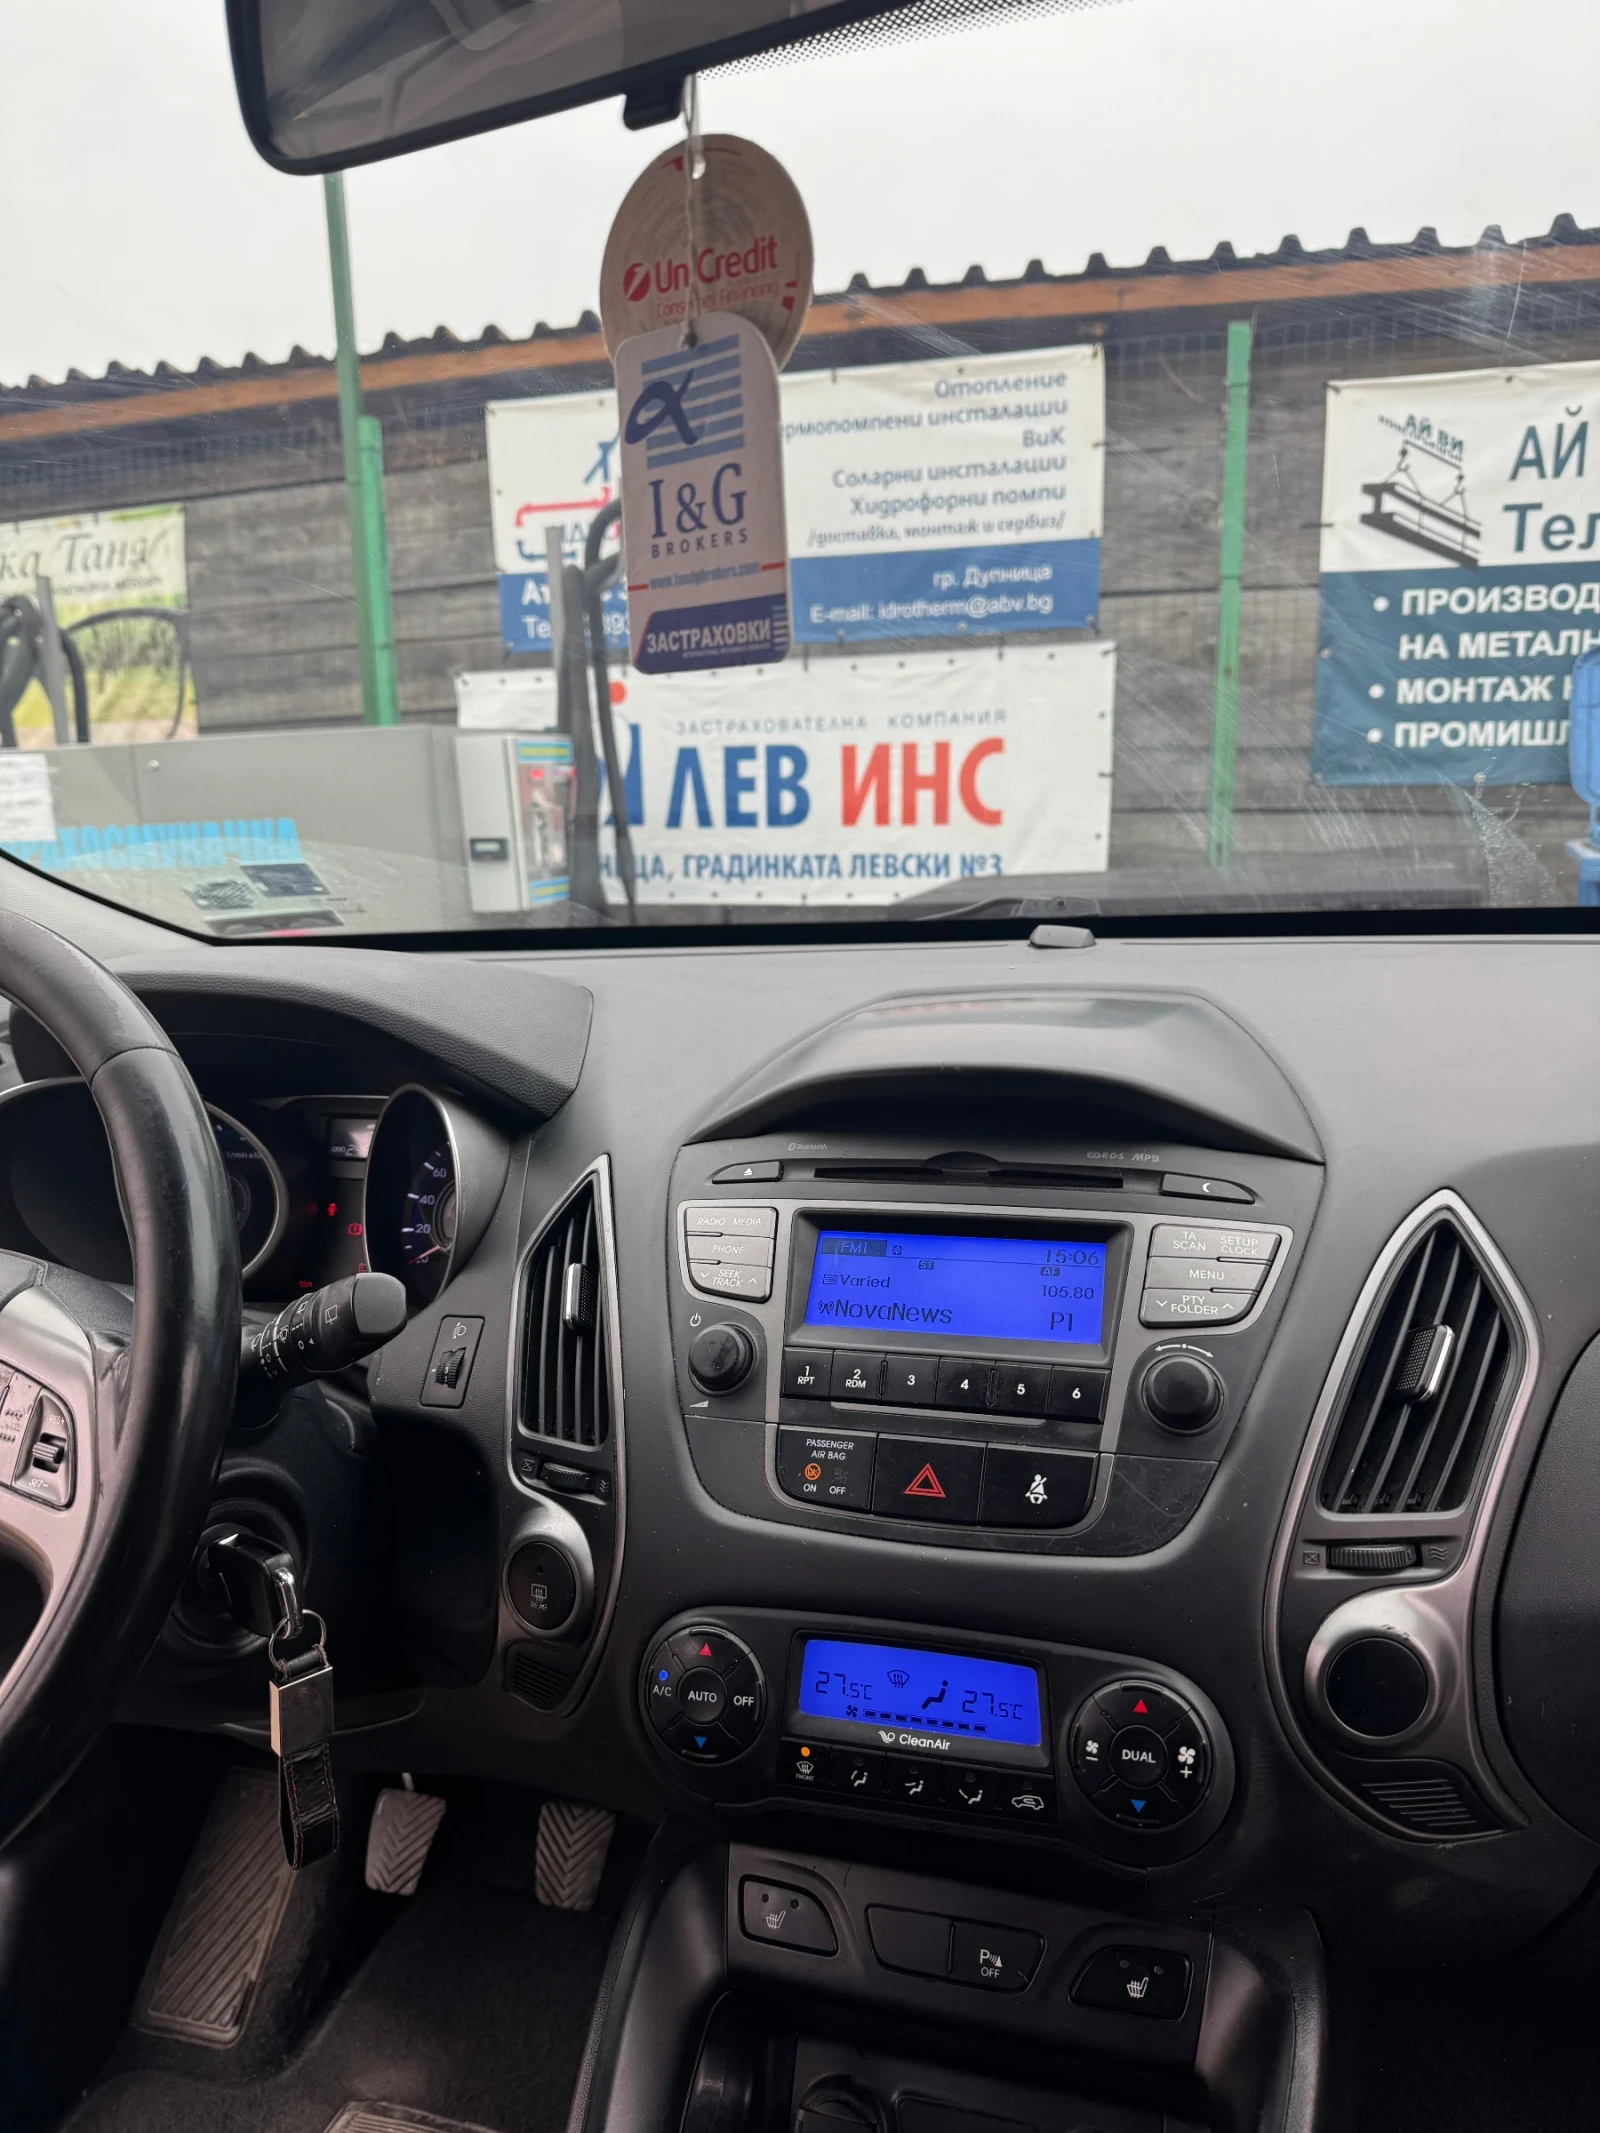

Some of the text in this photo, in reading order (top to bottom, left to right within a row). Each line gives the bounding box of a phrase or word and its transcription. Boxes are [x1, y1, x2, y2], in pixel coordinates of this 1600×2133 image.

[655, 234, 778, 294] UnCredit
[934, 371, 1067, 399] Отопление
[781, 399, 1067, 442] рмопомпени инсталации
[1022, 426, 1066, 448] ВиК
[1509, 404, 1590, 481] АЙ
[832, 454, 1066, 490] Соларни инсталации
[649, 463, 747, 539] I&G
[850, 485, 1066, 518] Хидрофорни помпи
[651, 528, 748, 559] BROKERS
[962, 563, 1052, 588] Дупница
[647, 618, 770, 654] ЗАСТРАХОВКИ
[1399, 632, 1449, 661] НА
[1396, 674, 1553, 704] МОНТАЖ
[676, 707, 1008, 735] ЗАСТРАХОВАТЕЛНА КОМПАНИЯ
[665, 737, 1004, 829] ЛЕВ ИНС
[683, 854, 843, 885] ГРАДИНКАТА
[850, 852, 951, 878] ЛЕВСКИ
[433, 1168, 446, 1178] 60
[420, 1195, 435, 1205] 40
[697, 1217, 762, 1226] RADIO MEDIA
[415, 1223, 431, 1234] 20
[1182, 1231, 1196, 1240] TA
[1220, 1235, 1258, 1247] SETUP
[712, 1245, 744, 1254] PHONE
[840, 1241, 867, 1254] FM1
[1173, 1240, 1206, 1251] SCAN
[1221, 1245, 1258, 1256] CLOCK
[1044, 1249, 1099, 1266] 15:06
[719, 1269, 742, 1279] SEEK
[1189, 1269, 1225, 1280] MENU
[712, 1277, 743, 1288] TRACK
[840, 1274, 1094, 1299] Varied 105.80
[1182, 1295, 1205, 1305] PTY
[834, 1300, 953, 1324] NovaNews
[1171, 1303, 1218, 1315] FOLDER
[804, 1366, 810, 1376] 1
[854, 1369, 861, 1379] 2
[797, 1376, 815, 1385] RPT
[845, 1379, 866, 1389] RDM
[907, 1375, 916, 1385] 3
[960, 1379, 969, 1390] 4
[1017, 1384, 1025, 1395] 5
[1073, 1388, 1081, 1399] 6
[806, 1438, 854, 1450] PASSENGER
[811, 1450, 846, 1461] AIR BAG
[803, 1483, 817, 1493] ON
[829, 1485, 846, 1495] OFF
[653, 1685, 672, 1697] A/C
[688, 1690, 717, 1702] AUTO
[733, 1695, 754, 1707] OFF
[899, 1733, 950, 1751] CleanAir
[1122, 1749, 1156, 1764] DUAL
[981, 1966, 1000, 1979] OFF
